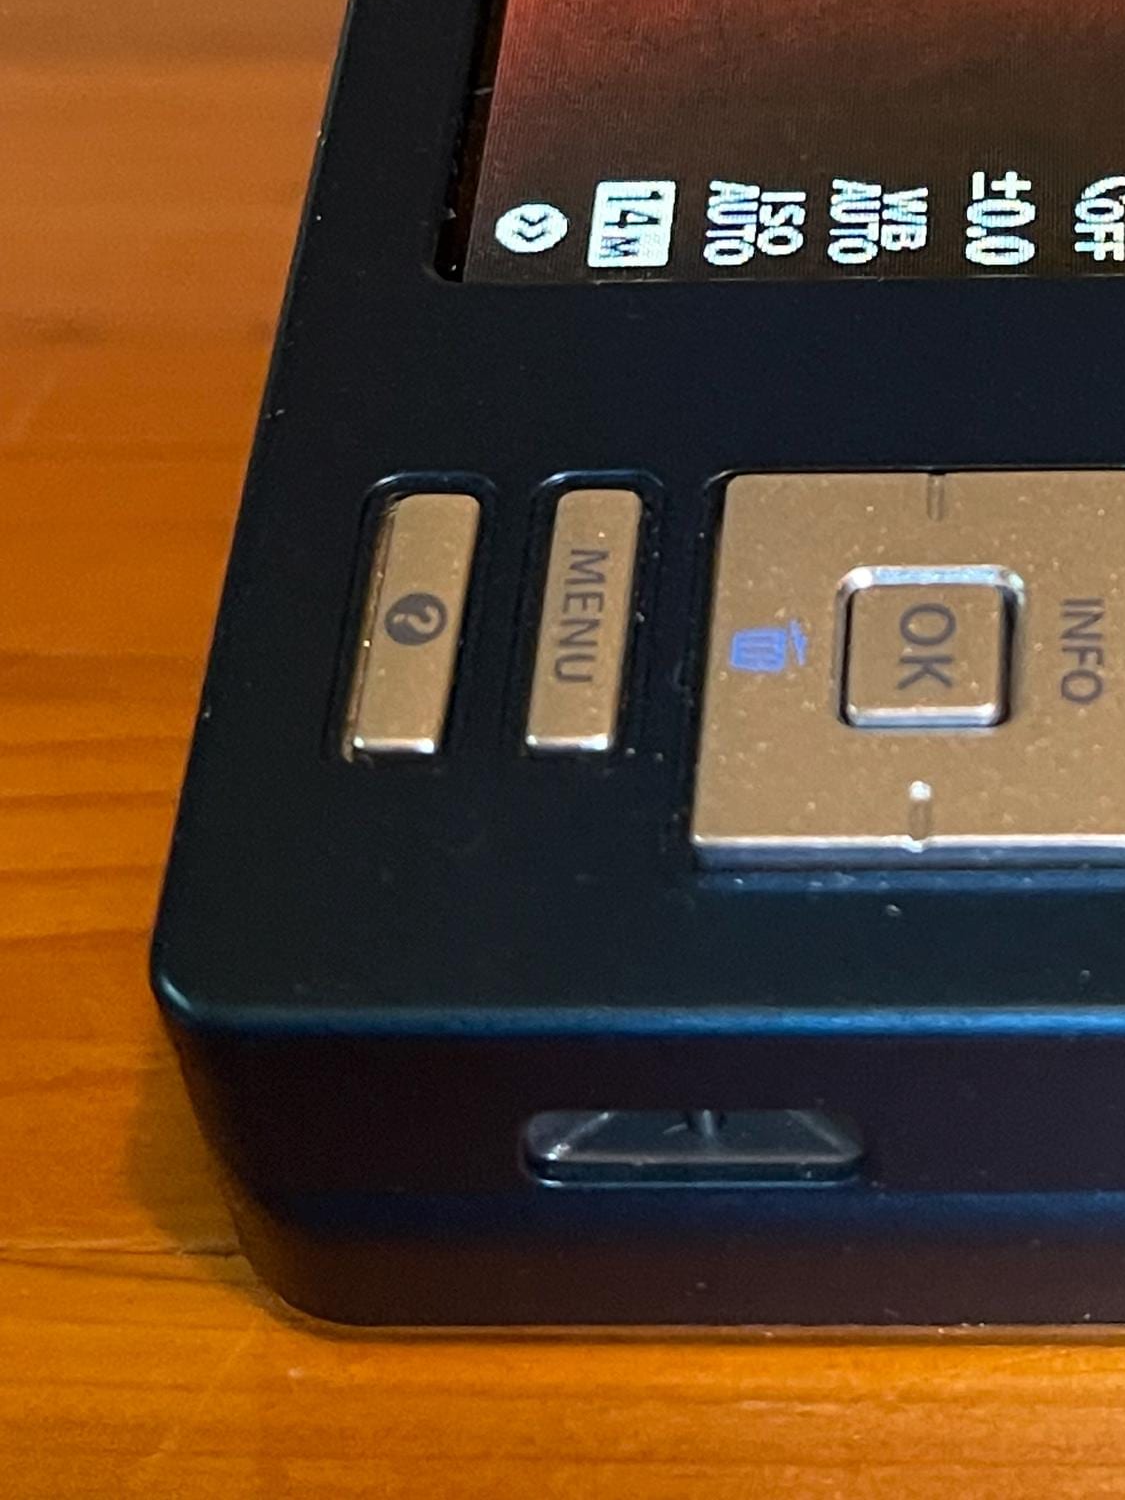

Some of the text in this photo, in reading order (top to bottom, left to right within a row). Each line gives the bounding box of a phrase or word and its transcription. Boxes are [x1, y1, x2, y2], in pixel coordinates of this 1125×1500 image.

[703, 180, 760, 267] AUTO
[758, 191, 806, 257] ISO
[827, 179, 882, 265] AUTO
[881, 187, 929, 252] WB
[553, 548, 609, 684] MENU
[898, 603, 957, 690] OK
[1060, 597, 1105, 705] INFO
